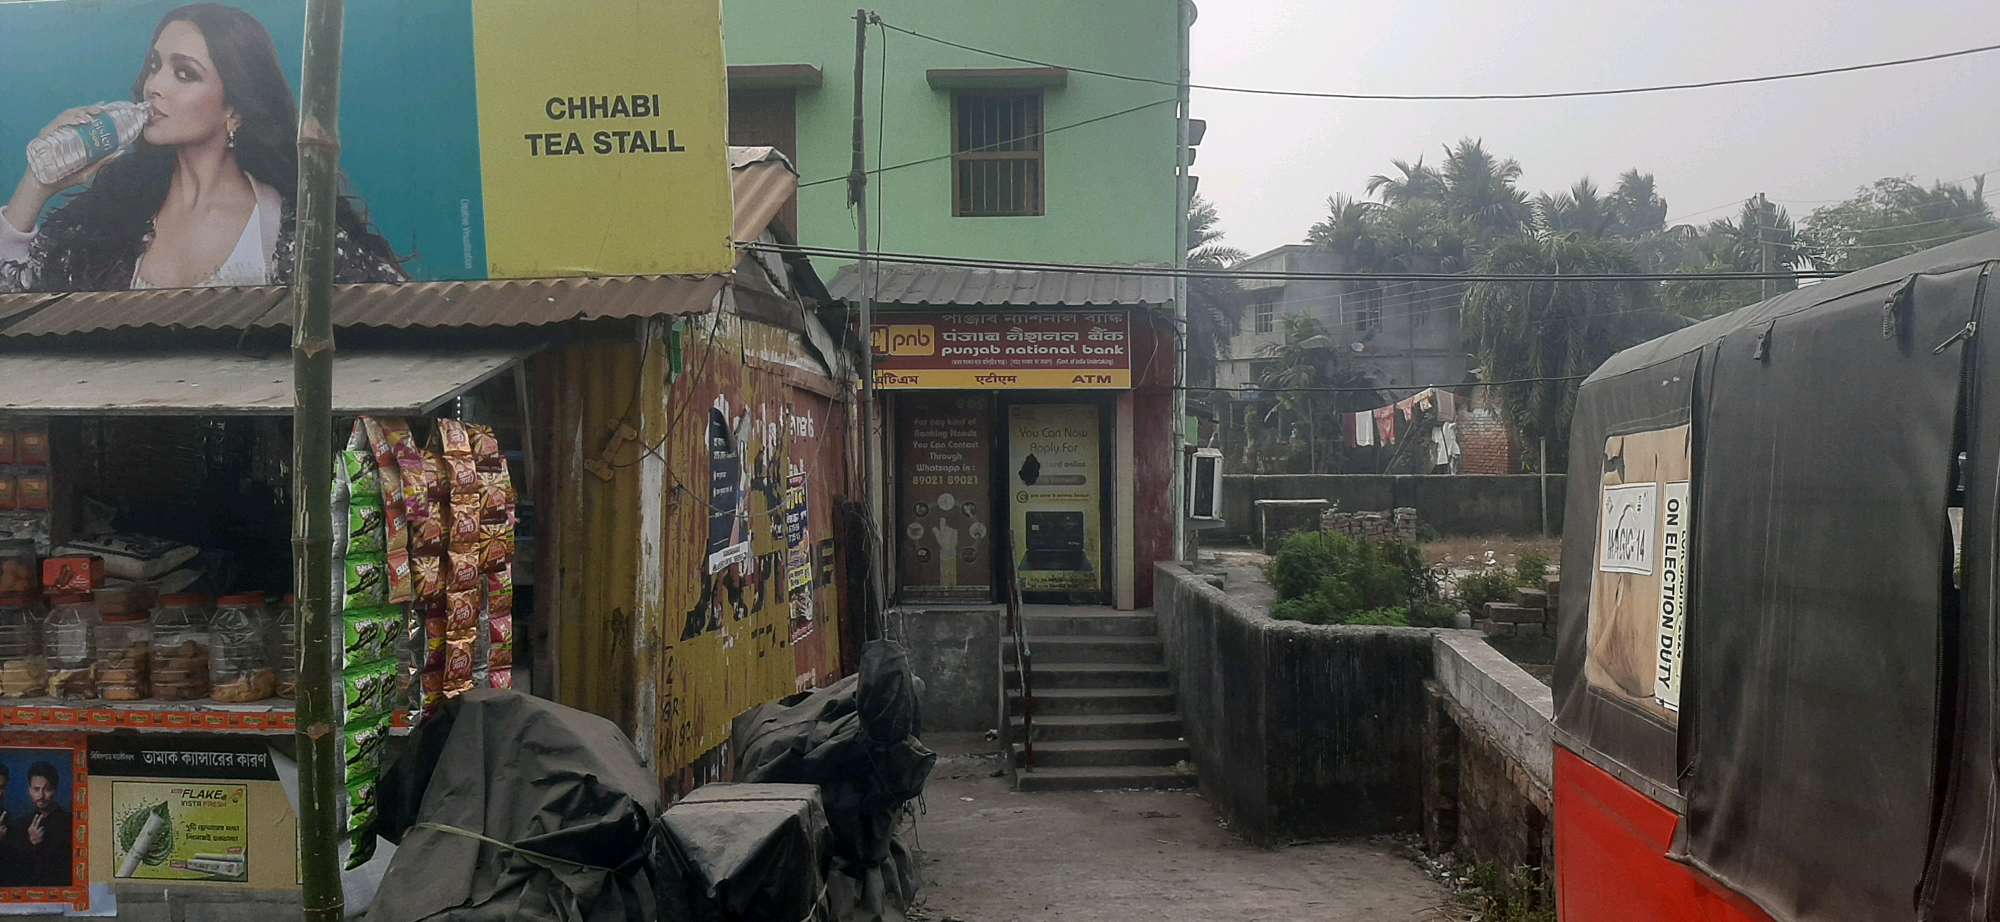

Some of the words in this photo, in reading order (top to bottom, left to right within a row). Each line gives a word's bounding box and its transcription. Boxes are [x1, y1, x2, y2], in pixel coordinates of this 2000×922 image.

[545, 94, 660, 120] CHHABI
[524, 132, 585, 156] TEA
[593, 130, 686, 154] STALL
[892, 329, 930, 353] pnb
[942, 328, 1000, 342] पंजाब
[1006, 326, 1079, 343] नैशनल
[1087, 326, 1124, 341] बैंक
[942, 344, 1000, 357] punjab
[1006, 344, 1076, 355] national
[1082, 344, 1124, 355] bank
[975, 372, 1017, 385] एटीएम
[1071, 375, 1112, 383] ATM
[1019, 428, 1039, 438] You
[1041, 427, 1061, 438] Can
[1064, 427, 1088, 438] Now
[1030, 443, 1059, 454] Apply
[1062, 442, 1079, 453] For
[929, 452, 962, 462] Through
[916, 464, 960, 473] Whatsapp
[1667, 499, 1679, 526] ON
[1661, 533, 1678, 629] ELECTION
[1658, 634, 1674, 689] DUTY
[142, 750, 179, 765] তামাক
[180, 751, 235, 767] ক্যান্সারের
[236, 752, 268, 768] কারণ
[181, 788, 222, 799] FLAKE
